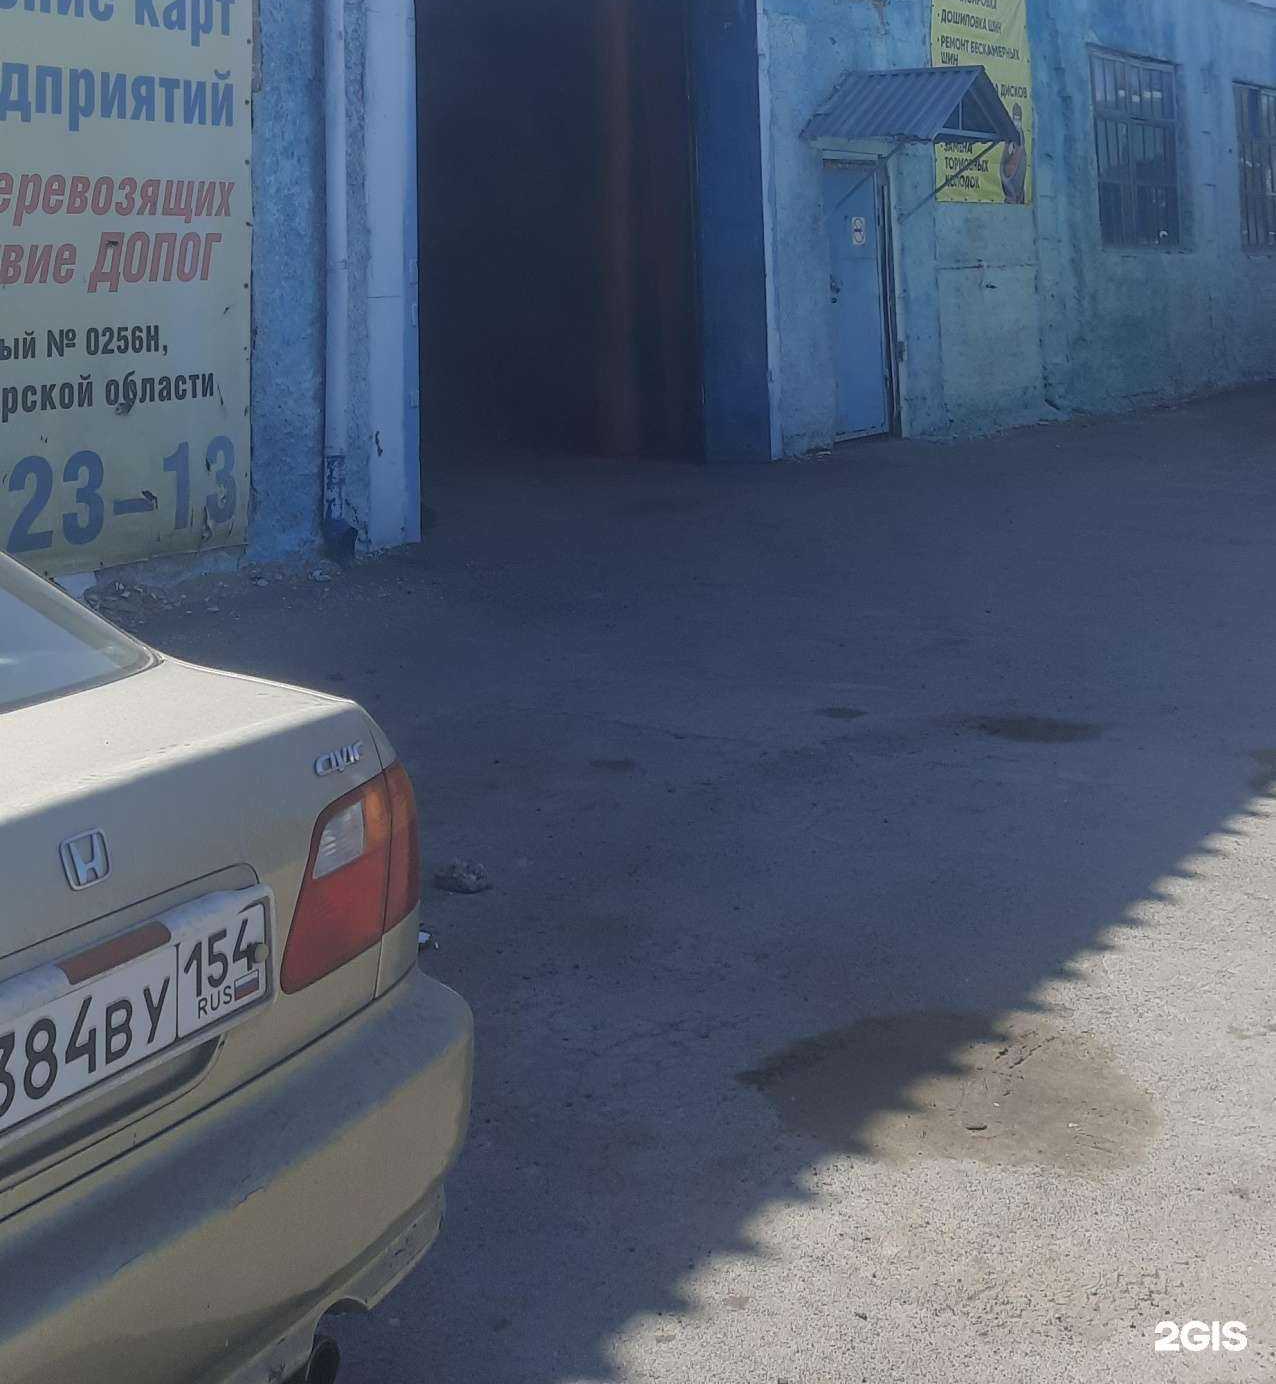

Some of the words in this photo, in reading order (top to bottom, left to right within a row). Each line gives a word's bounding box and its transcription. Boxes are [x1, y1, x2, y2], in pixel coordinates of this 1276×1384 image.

[940, 34, 969, 54] РЕМОНТ
[970, 40, 1021, 61] БЕСКАМЕРНЫХ
[940, 50, 959, 66] ШИН
[0, 62, 235, 127] дприятий
[87, 231, 223, 293] ДОПОГ
[0, 330, 36, 360] ый
[2, 374, 94, 423] рской
[105, 370, 215, 408] области
[183, 918, 253, 998] 154
[198, 985, 232, 1019] RUS
